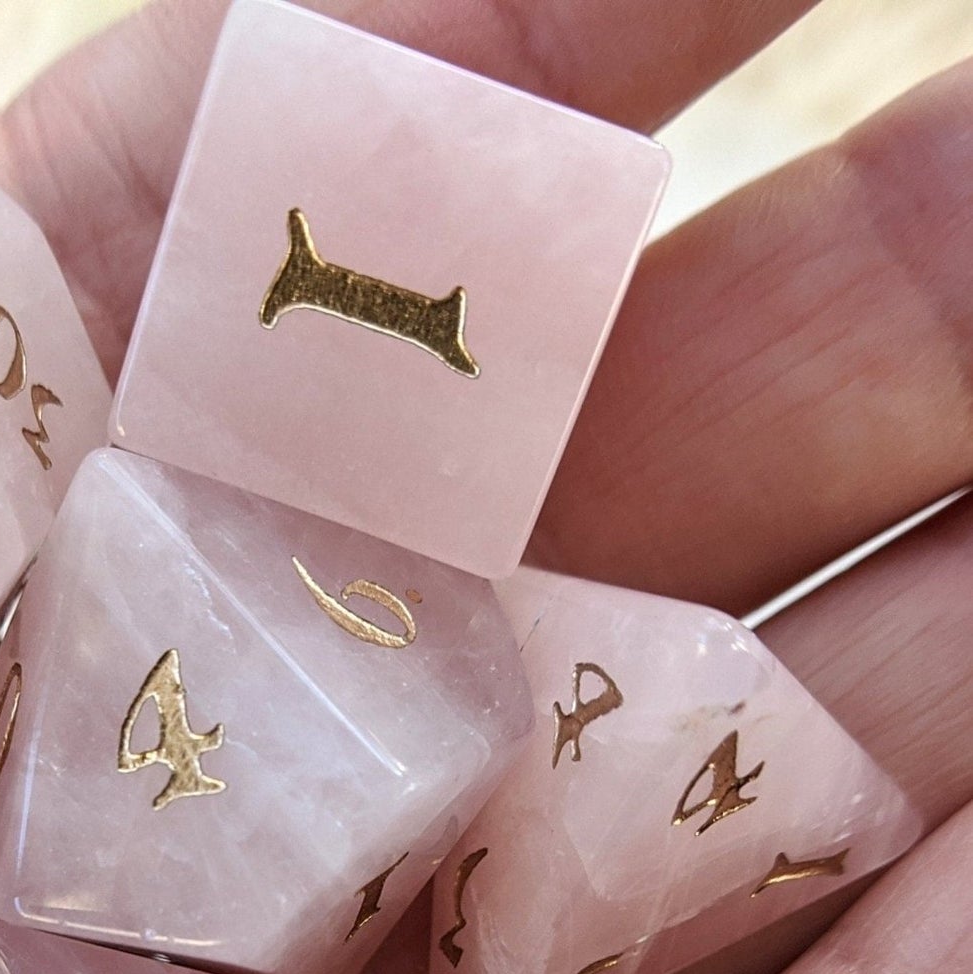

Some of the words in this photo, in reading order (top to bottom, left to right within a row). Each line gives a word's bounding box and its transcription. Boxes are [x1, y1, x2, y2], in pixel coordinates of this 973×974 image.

[259, 207, 480, 379] 1
[117, 648, 227, 812] 4
[670, 730, 765, 836] 4
